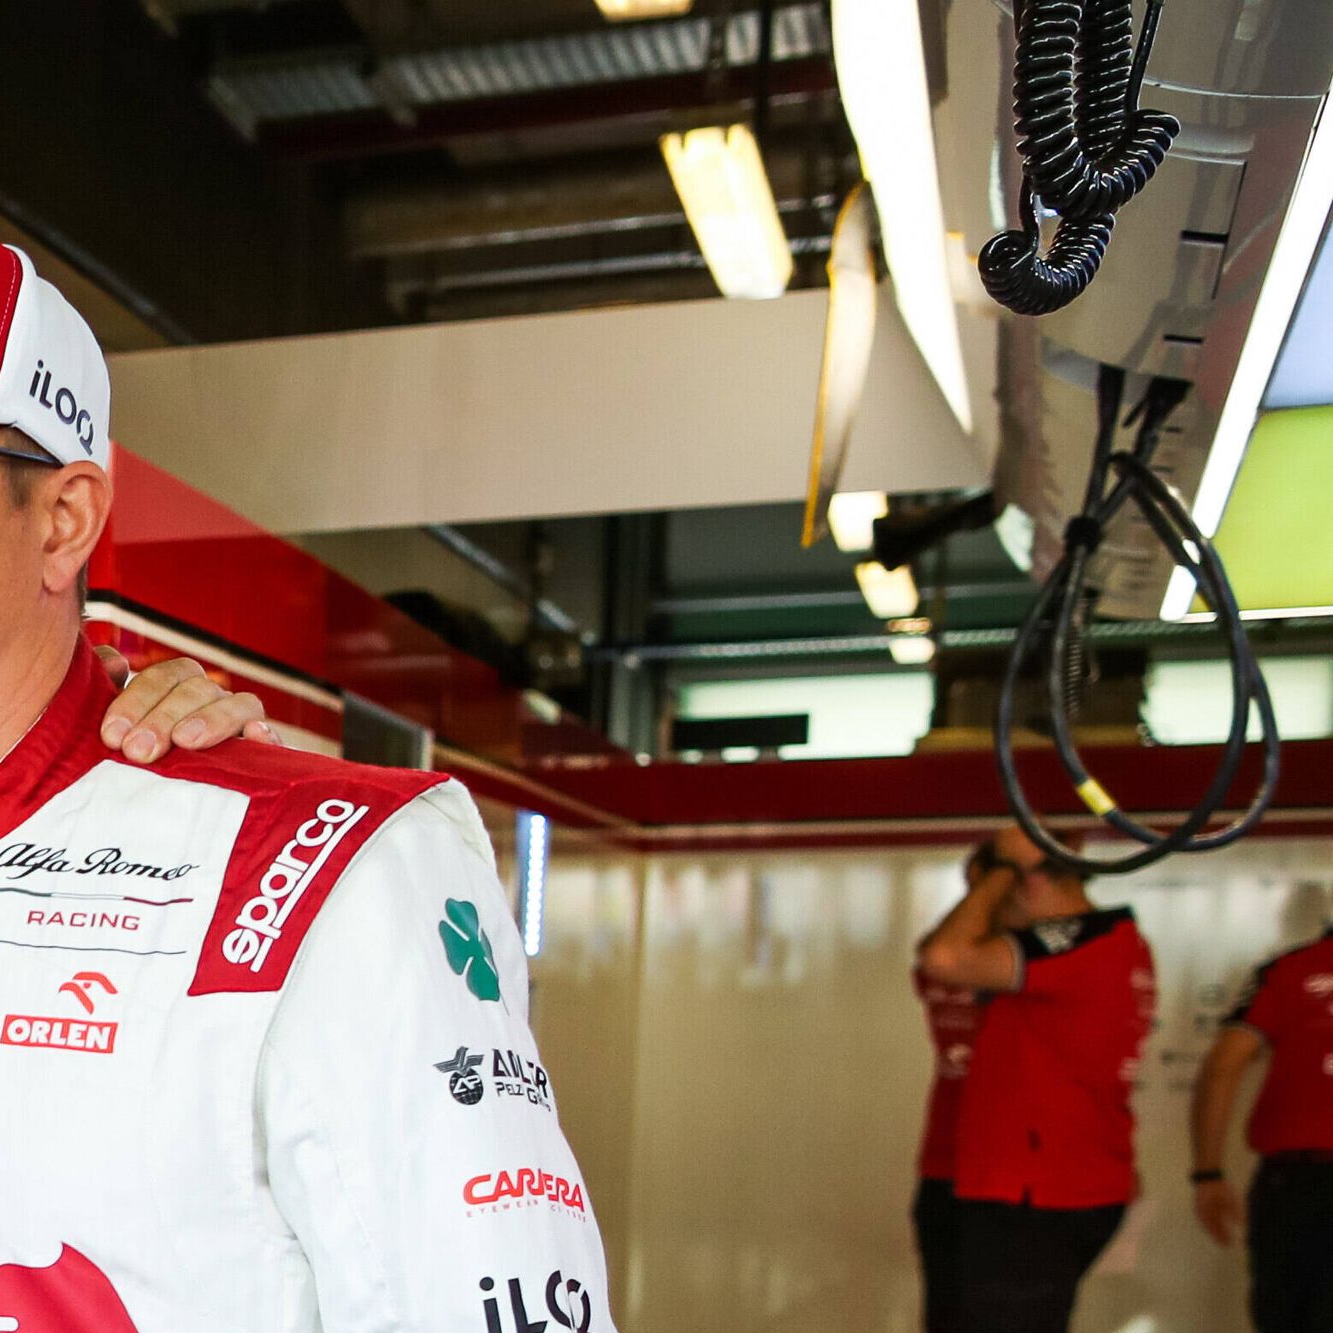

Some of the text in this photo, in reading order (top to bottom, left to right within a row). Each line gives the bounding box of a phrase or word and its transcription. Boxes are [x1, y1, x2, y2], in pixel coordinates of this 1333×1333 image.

[28, 359, 95, 456] iLOQ
[76, 847, 200, 881] Romeo
[222, 798, 365, 974] sparco
[26, 910, 141, 932] RACING
[6, 1018, 113, 1051] ORLEN
